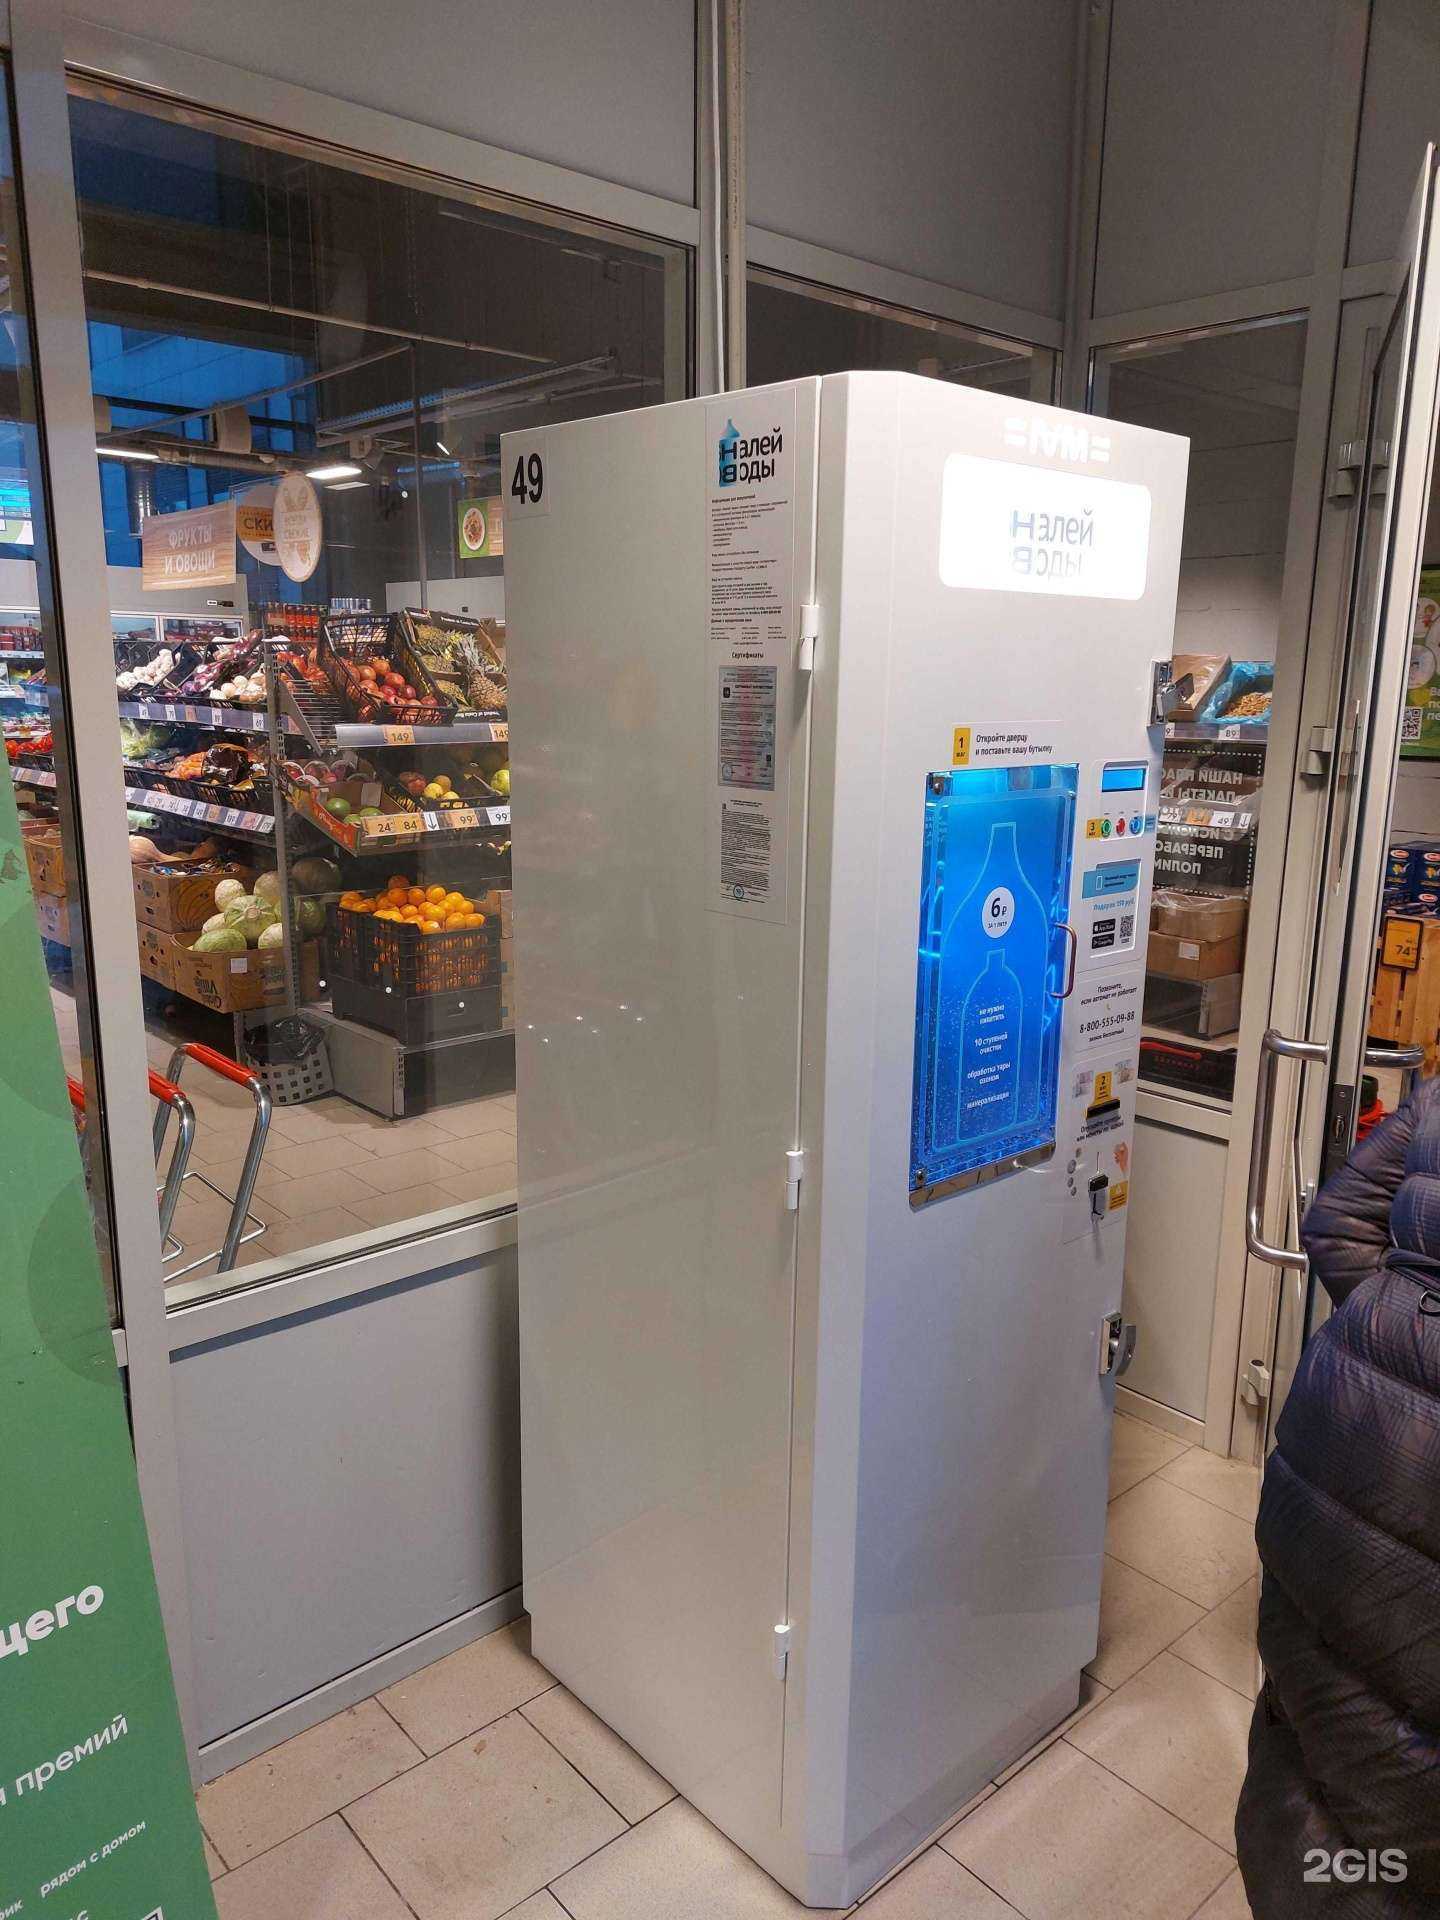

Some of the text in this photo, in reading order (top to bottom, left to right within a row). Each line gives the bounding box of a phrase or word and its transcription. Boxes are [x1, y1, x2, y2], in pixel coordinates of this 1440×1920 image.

[511, 452, 544, 505] 49
[168, 525, 212, 549] ФРУКТЫ
[164, 551, 216, 575] И ОВОЩИ
[390, 732, 410, 742] 149
[976, 732, 1028, 744] Откройте дверцу
[980, 747, 1011, 756] поставьте
[1012, 746, 1028, 755] вашу
[1028, 744, 1053, 755] бутылку
[1079, 1010, 1136, 1034] 8-800-555-09-88
[974, 1037, 983, 1047] 10
[15, 1713, 128, 1797] премий
[40, 1820, 147, 1899] рядом с домом
